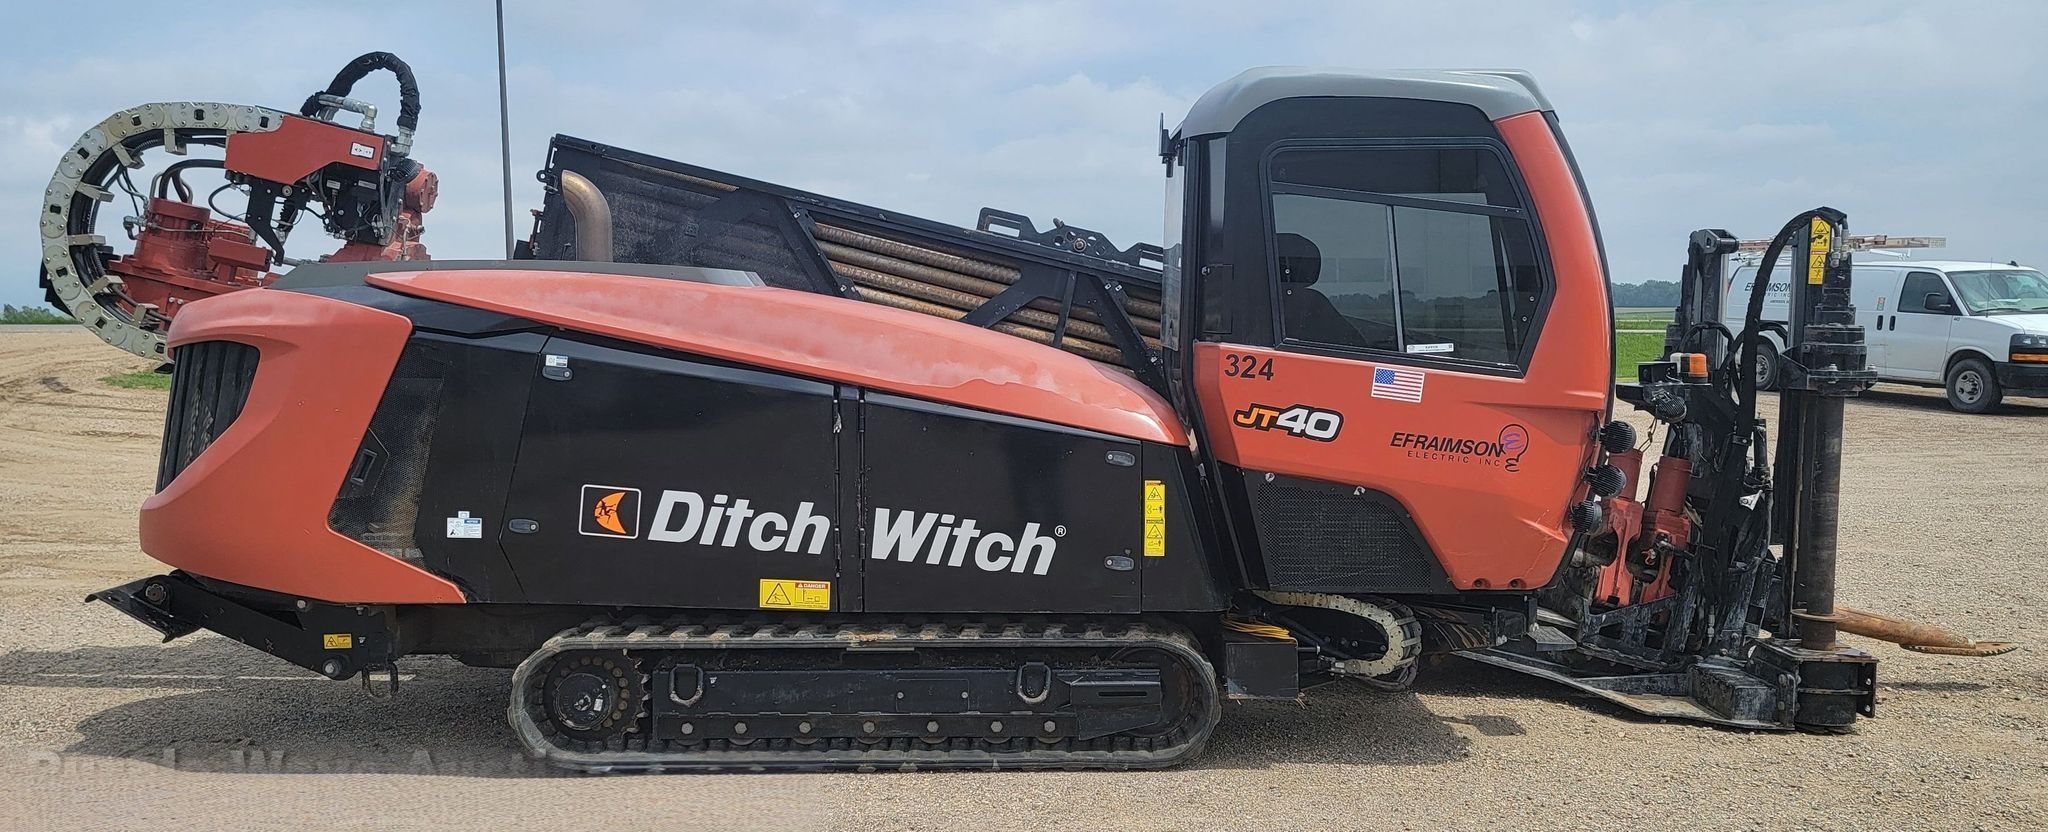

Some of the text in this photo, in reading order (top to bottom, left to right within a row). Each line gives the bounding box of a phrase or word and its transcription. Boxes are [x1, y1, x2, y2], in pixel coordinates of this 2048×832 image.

[1744, 282, 1791, 292] EMSON
[1224, 353, 1275, 381] 324
[1235, 405, 1342, 440] JT40
[1390, 432, 1502, 458] EFRAIMSON
[1407, 450, 1501, 468] ELECTRIC INC
[647, 489, 831, 555] Ditch
